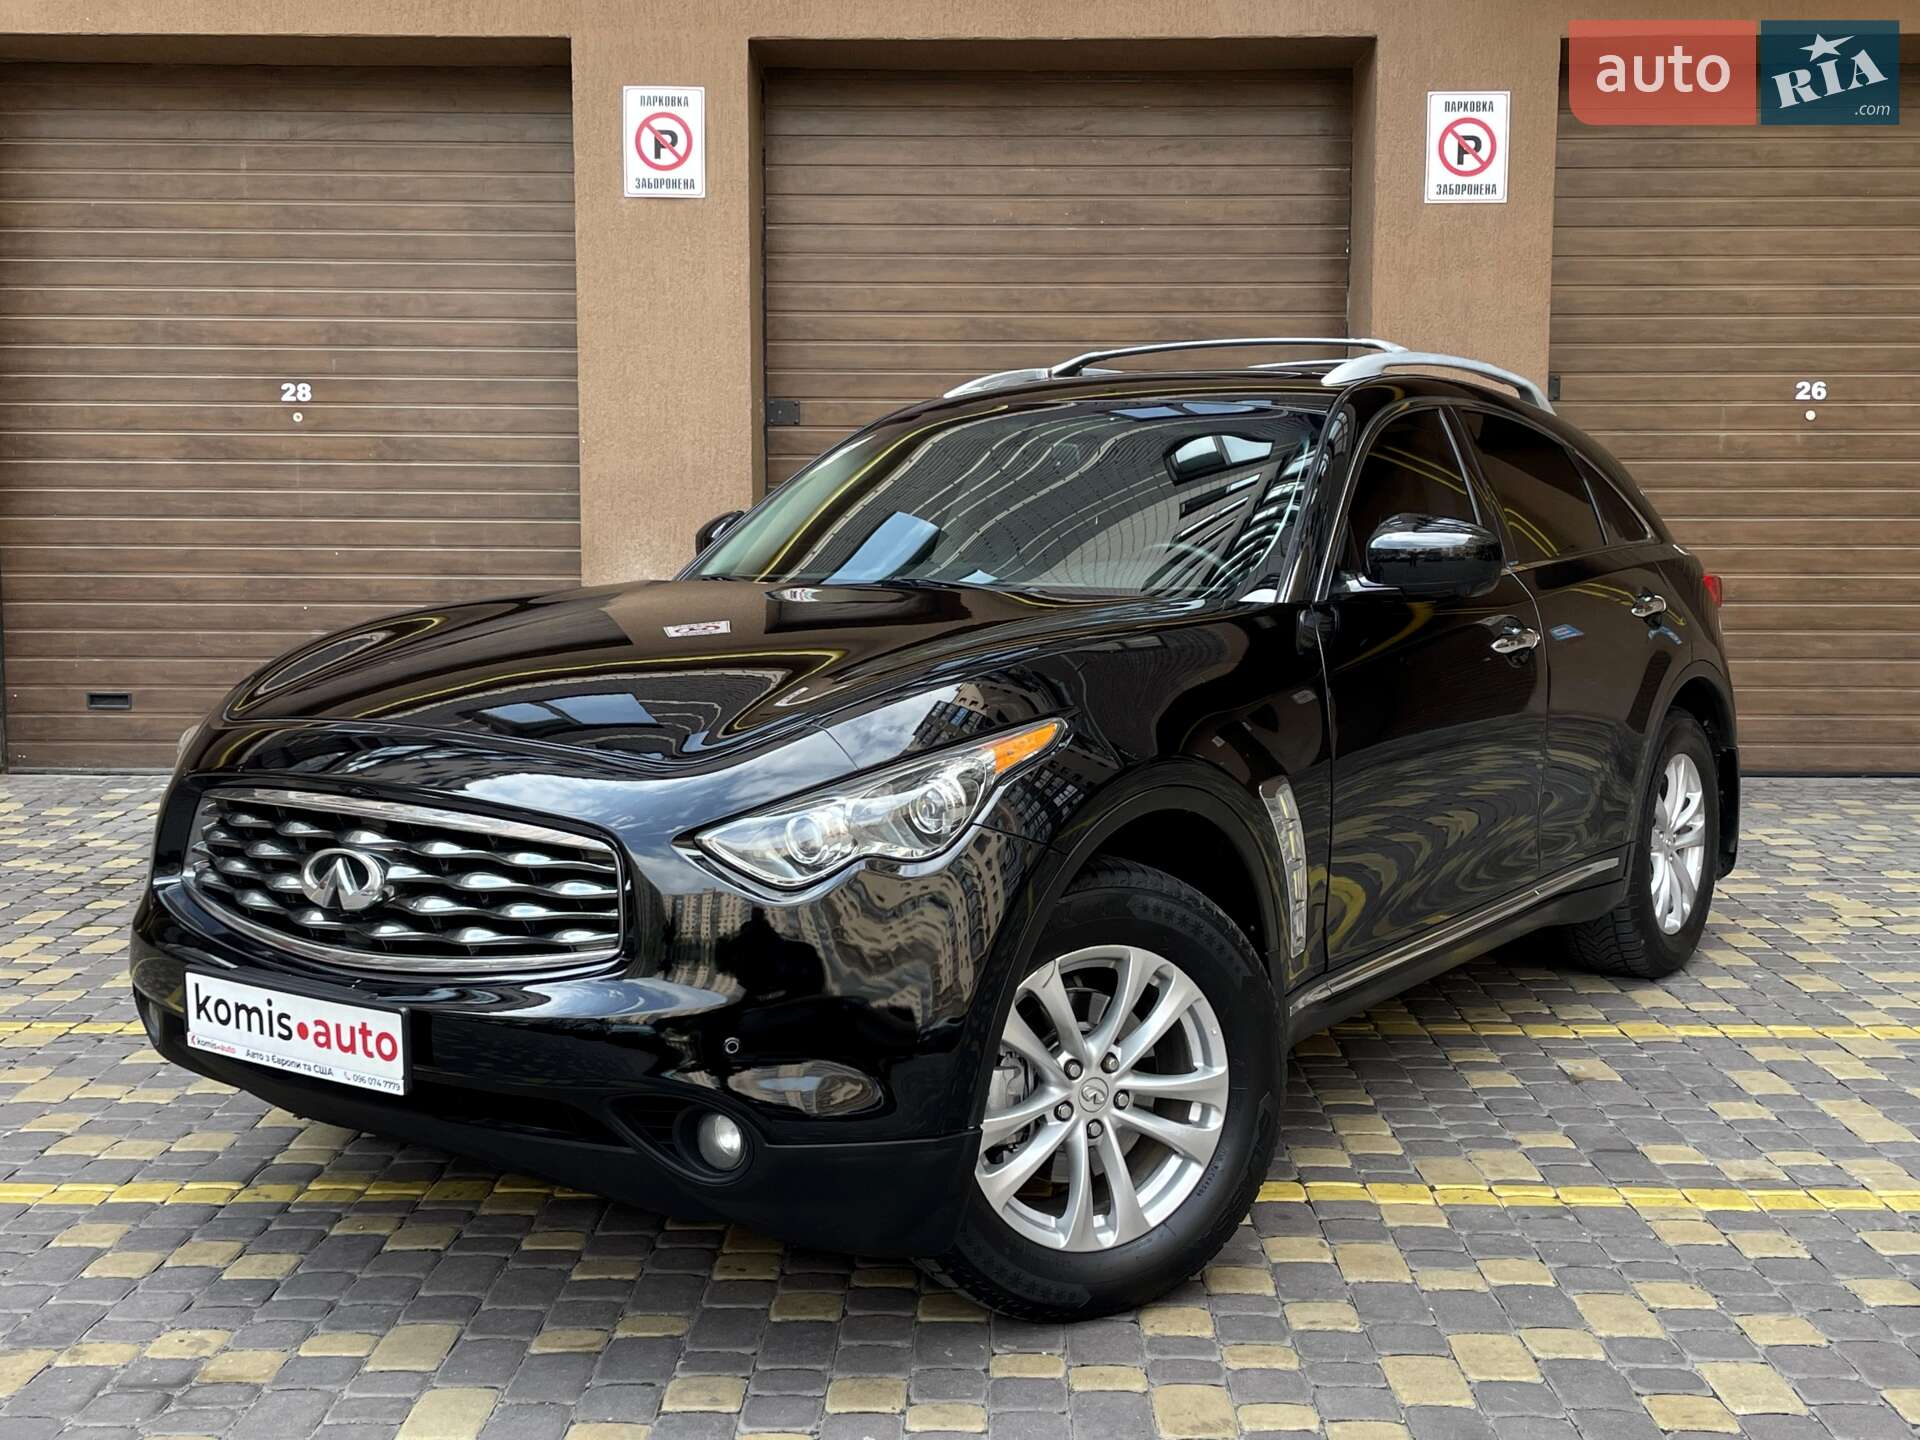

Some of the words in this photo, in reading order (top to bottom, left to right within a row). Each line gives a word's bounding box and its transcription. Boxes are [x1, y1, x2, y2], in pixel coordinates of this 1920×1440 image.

[640, 95, 689, 107] ПАРКОВКА
[1444, 100, 1494, 112] ПАРКОВКА
[635, 177, 695, 190] ЗАБОРОНЕНА
[1436, 183, 1497, 195] ЗАБОРОНЕНА
[281, 383, 312, 401] 28
[1795, 381, 1827, 400] 26
[246, 1049, 264, 1061] Авто
[271, 1054, 301, 1070] Європи
[303, 1063, 312, 1072] та
[313, 1064, 334, 1076] США
